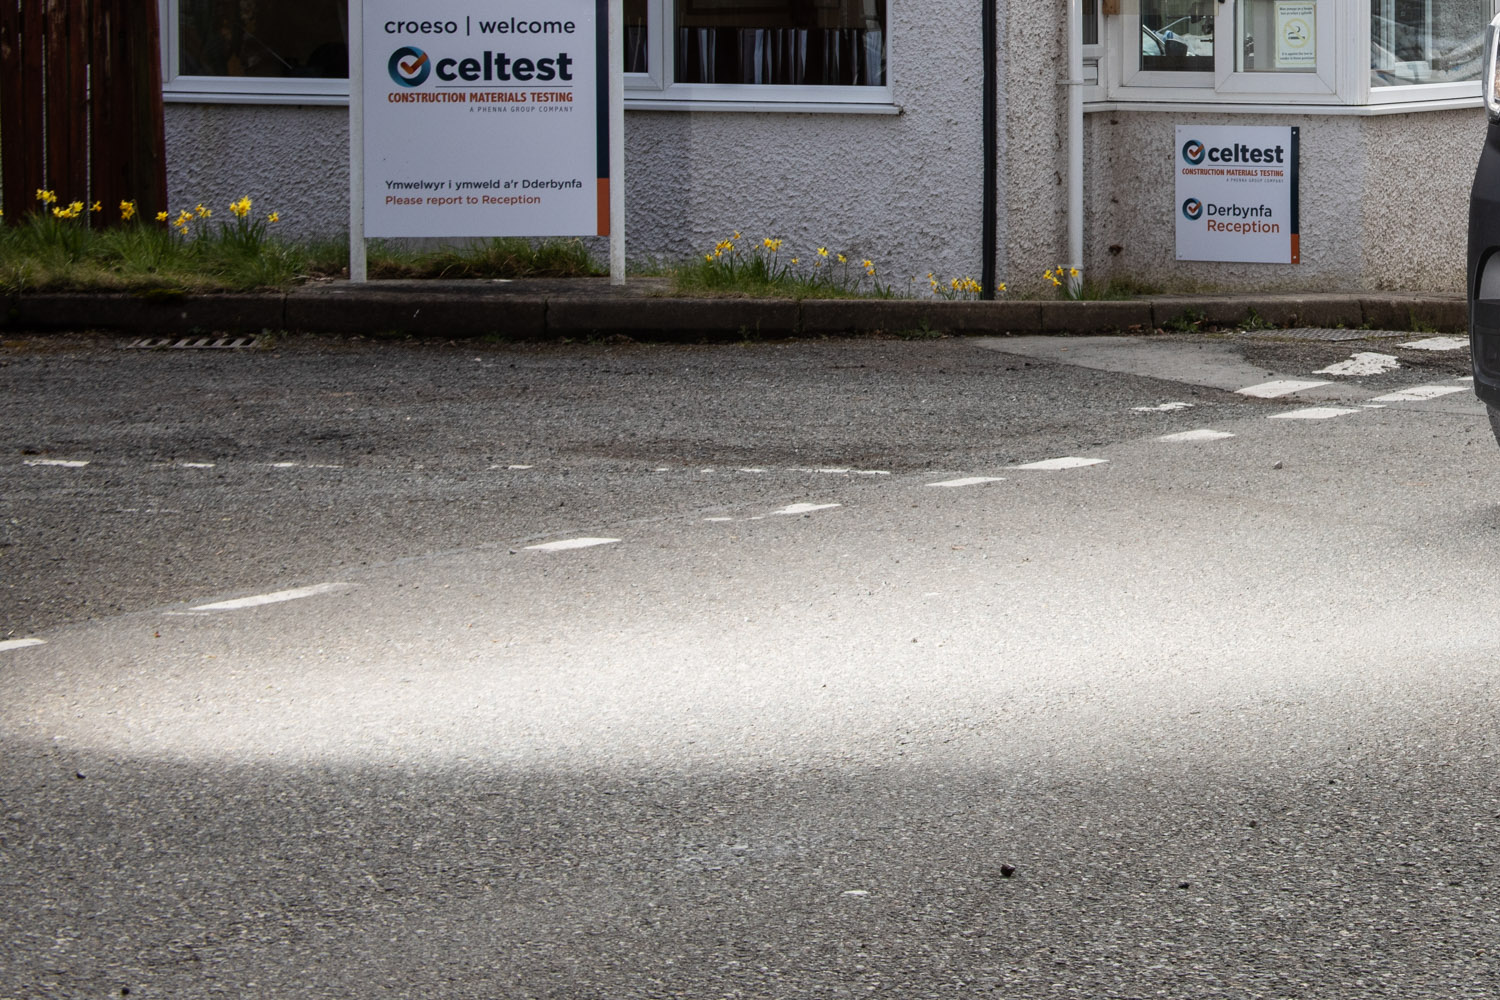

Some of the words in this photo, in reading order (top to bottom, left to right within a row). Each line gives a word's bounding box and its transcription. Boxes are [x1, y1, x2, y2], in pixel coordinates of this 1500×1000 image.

[384, 20, 458, 34] croeso
[479, 17, 575, 34] welcome
[435, 50, 573, 82] celtest
[388, 92, 465, 103] CONSTRUCTION
[469, 92, 527, 103] MATERIALS
[530, 92, 573, 103] TESTING
[1207, 143, 1284, 163] celtest
[1182, 168, 1225, 176] CONSTRUCTION
[1226, 169, 1258, 177] MATERIALS
[385, 180, 445, 191] Ymwelwyr
[448, 180, 452, 189] i
[455, 179, 500, 191] ymweld
[503, 180, 519, 189] a'r
[522, 179, 582, 191] Dderbynfa
[385, 195, 423, 205] Please
[426, 196, 463, 206] report
[466, 196, 479, 205] to
[482, 195, 541, 206] Reception
[1207, 203, 1272, 219] Derbynfa
[1207, 219, 1280, 235] Reception
